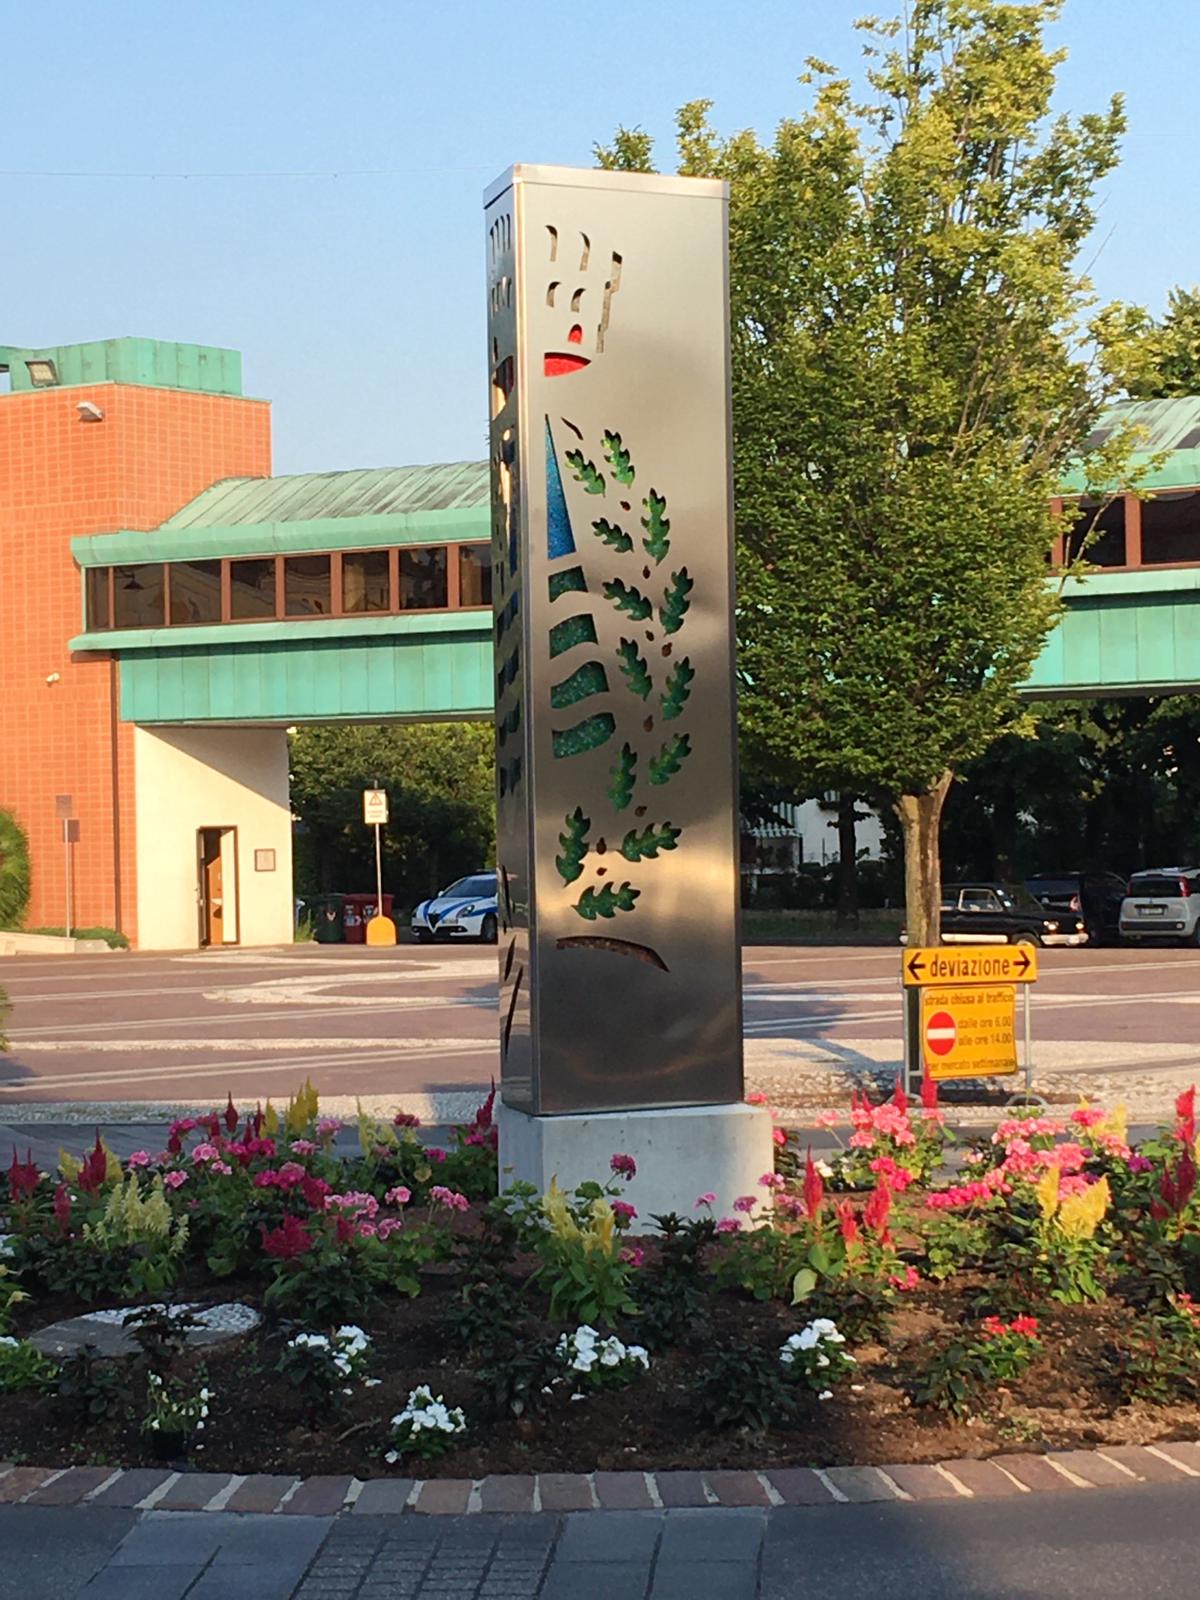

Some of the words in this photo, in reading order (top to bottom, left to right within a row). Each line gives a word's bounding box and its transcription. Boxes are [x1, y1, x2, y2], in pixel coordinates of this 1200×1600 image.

[930, 953, 1010, 977] deviazione
[925, 995, 949, 1006] strada
[986, 992, 1013, 1004] traffico
[958, 1018, 977, 1028] dalle
[980, 1019, 993, 1027] ore
[975, 1036, 989, 1045] ore
